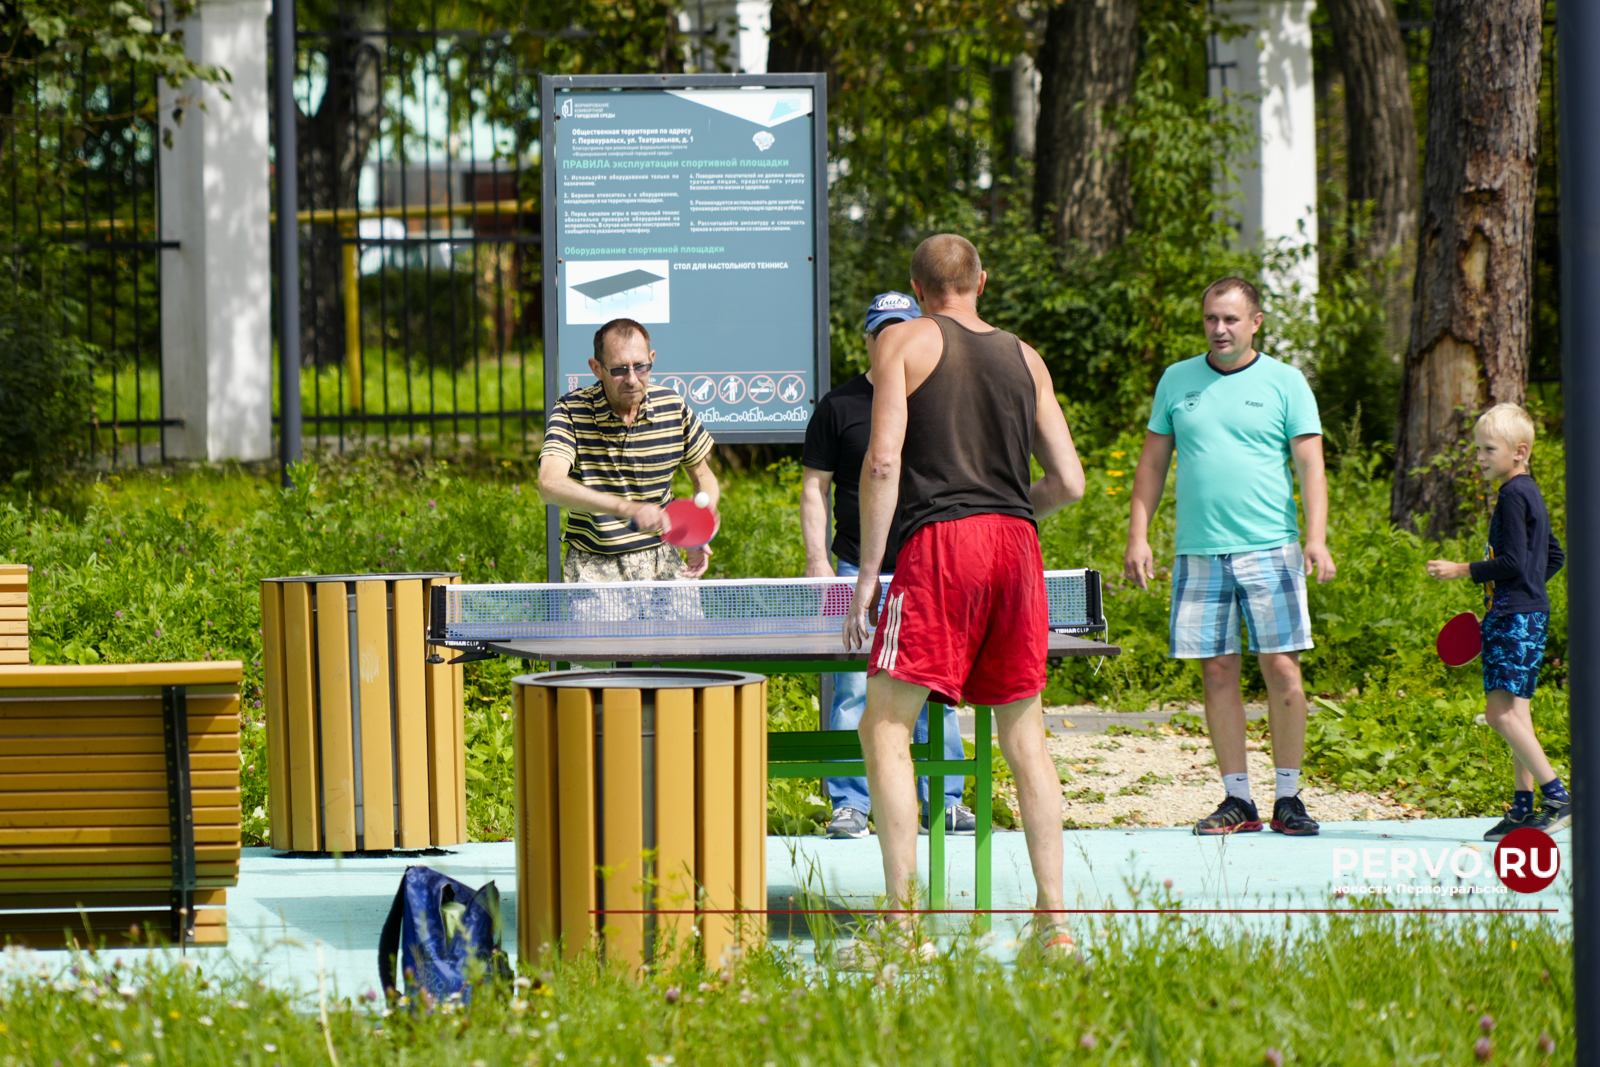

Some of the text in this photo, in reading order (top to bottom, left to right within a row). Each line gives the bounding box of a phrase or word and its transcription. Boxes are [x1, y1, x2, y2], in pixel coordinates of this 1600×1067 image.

[572, 128, 620, 136] Общественная
[621, 128, 659, 136] территория
[578, 137, 627, 145] Первоуральск,
[638, 136, 681, 144] Театральная,
[690, 135, 694, 143] 1
[562, 157, 790, 170] ПРАВИЛА эксплуатации спортивной площадки
[695, 199, 734, 207] Рекомендуется
[564, 245, 725, 256] Оборудование спортивной площадки
[673, 261, 789, 271] СТОЛ ДЛЯ НАСТОЛЬНОГО ТЕННИСА
[568, 376, 579, 384] 03
